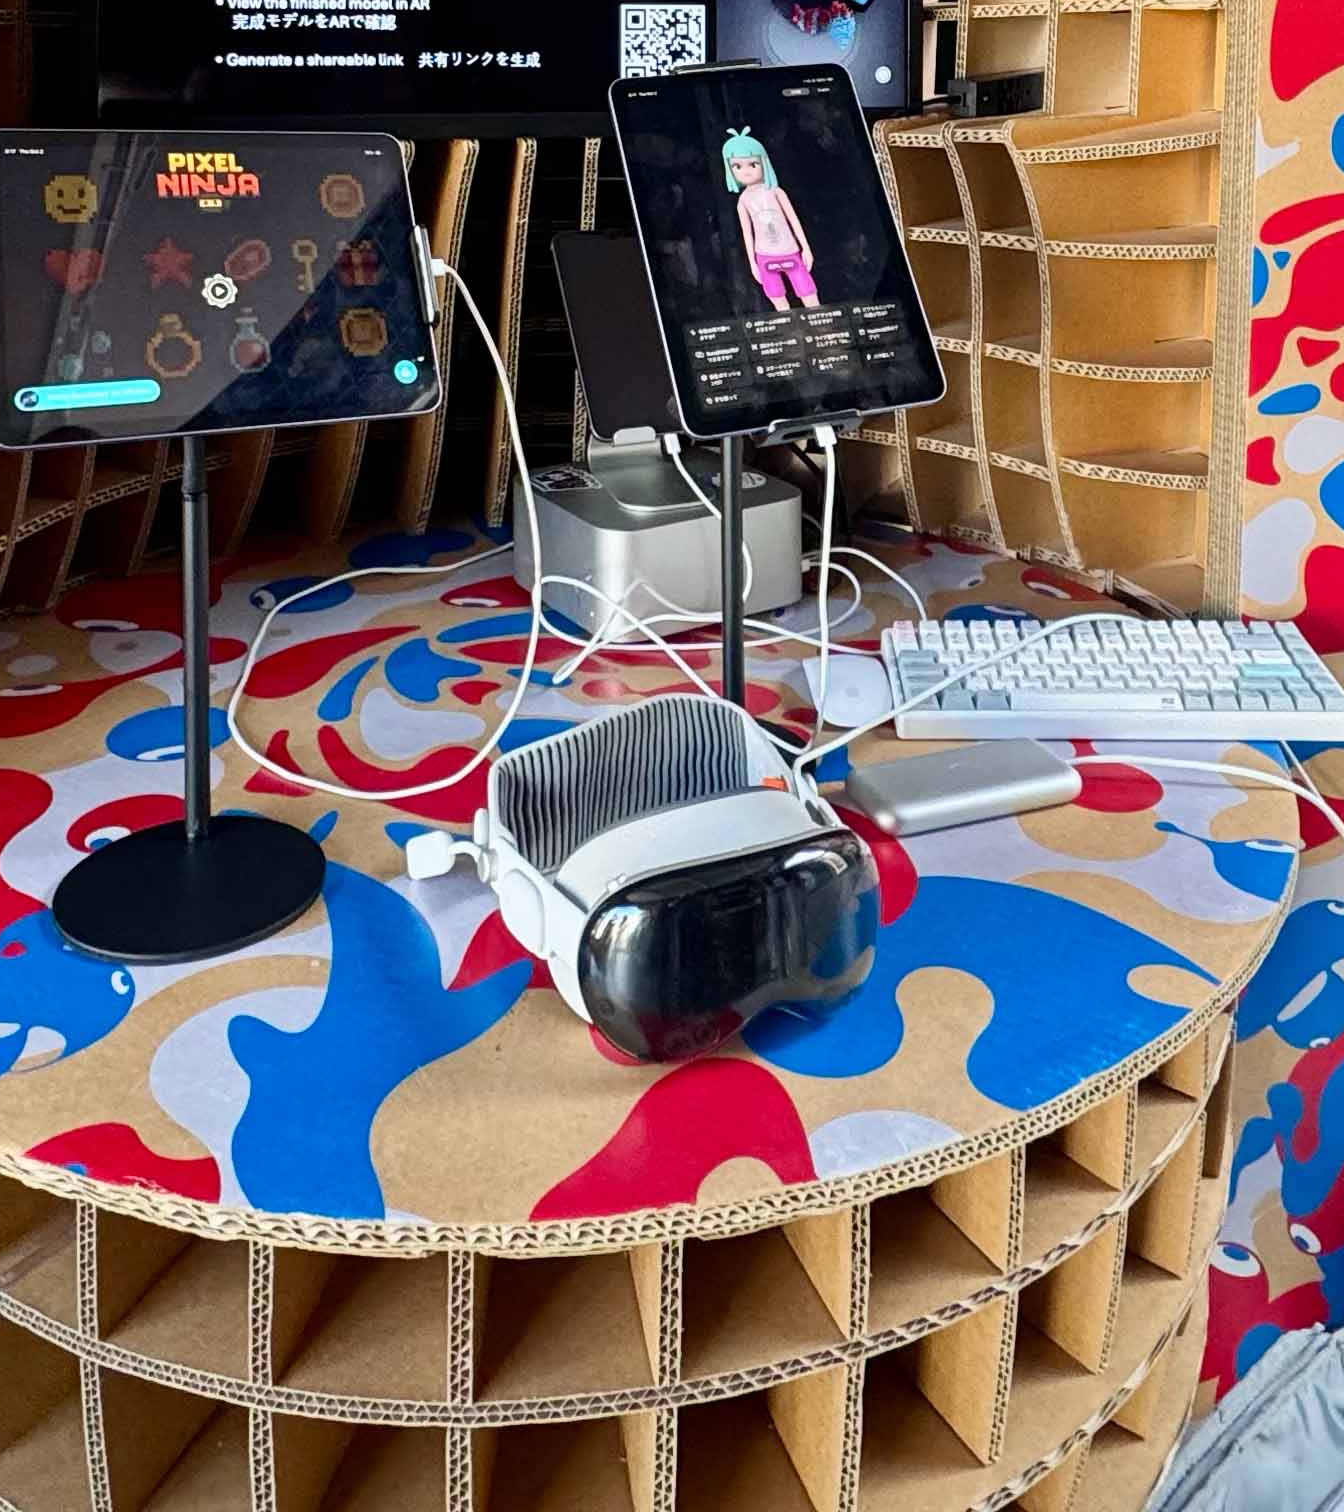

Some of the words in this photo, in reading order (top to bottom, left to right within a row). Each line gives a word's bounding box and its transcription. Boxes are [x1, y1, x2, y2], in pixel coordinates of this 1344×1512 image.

[232, 13, 397, 30] 完成モデルをARで確認
[226, 53, 292, 67] Generate
[294, 55, 304, 67] a
[307, 53, 376, 67] shareable
[378, 53, 404, 67] link
[419, 51, 541, 68] 共有リンクを生成
[168, 153, 243, 173] PIXEL
[156, 174, 259, 197] NINJA
